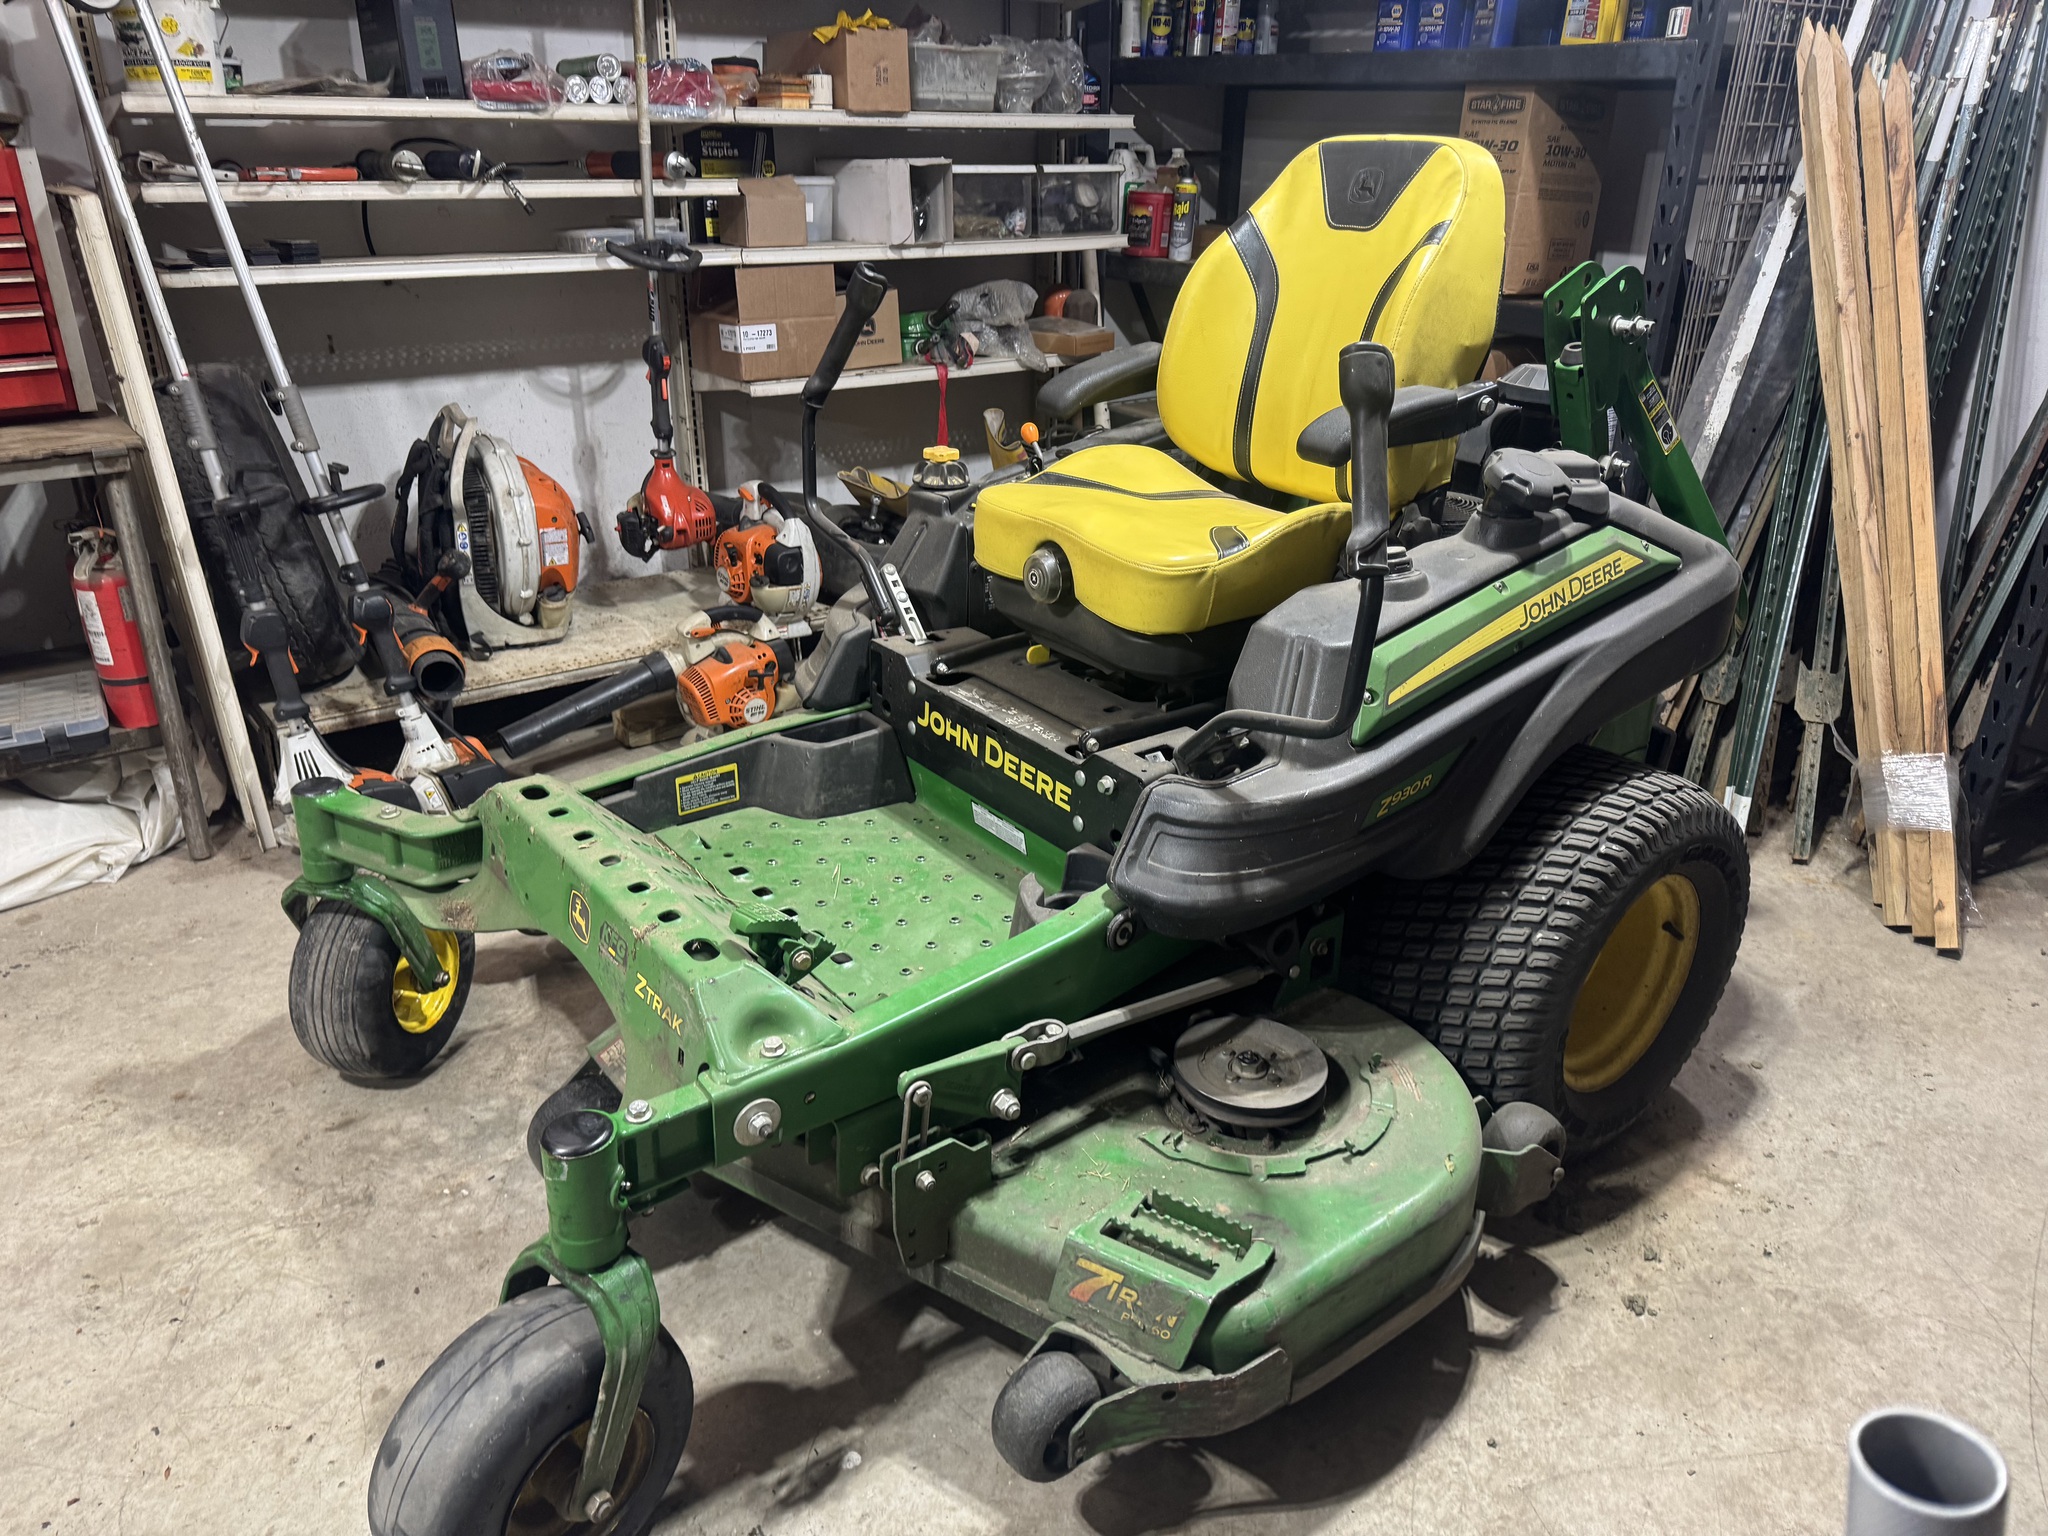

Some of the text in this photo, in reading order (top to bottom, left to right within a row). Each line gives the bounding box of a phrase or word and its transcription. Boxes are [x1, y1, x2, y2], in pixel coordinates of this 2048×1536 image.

[1152, 17, 1171, 28] WD-40
[1470, 99, 1521, 110] STAR FIRE
[1464, 131, 1479, 139] SAE
[1546, 135, 1561, 143] SAE
[702, 146, 739, 158] Staples
[1545, 144, 1587, 159] 10W-30
[1542, 160, 1566, 168] MOTOR
[1519, 556, 1625, 629] JOHN DEERE
[917, 700, 979, 758] JOHN
[985, 735, 1072, 812] DEERE
[1376, 773, 1433, 818] Z930R
[634, 972, 684, 1036] ZTRAK
